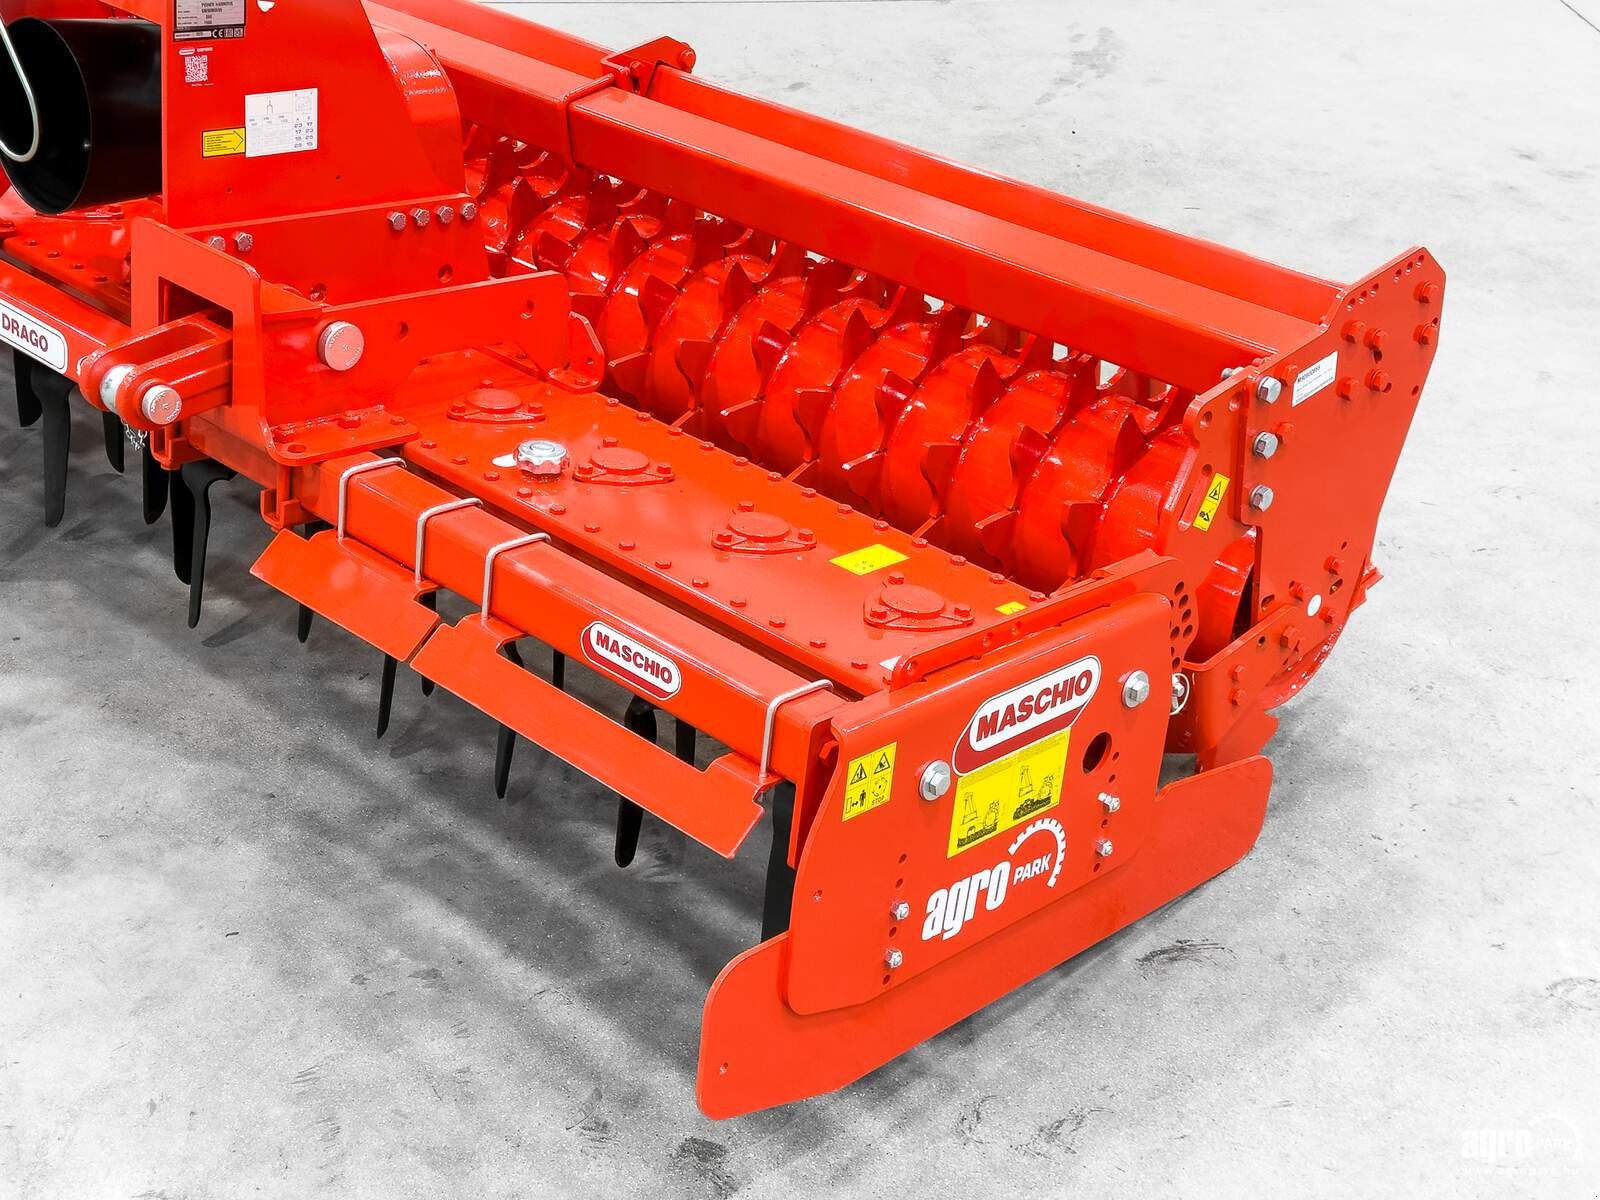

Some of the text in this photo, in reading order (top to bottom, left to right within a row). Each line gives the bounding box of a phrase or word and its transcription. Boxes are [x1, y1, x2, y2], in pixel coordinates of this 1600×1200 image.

[2, 312, 48, 352] DRAGO
[596, 630, 673, 684] MASCHIO
[975, 669, 1092, 742] MASCHIO
[921, 853, 1052, 941] agro PARK
